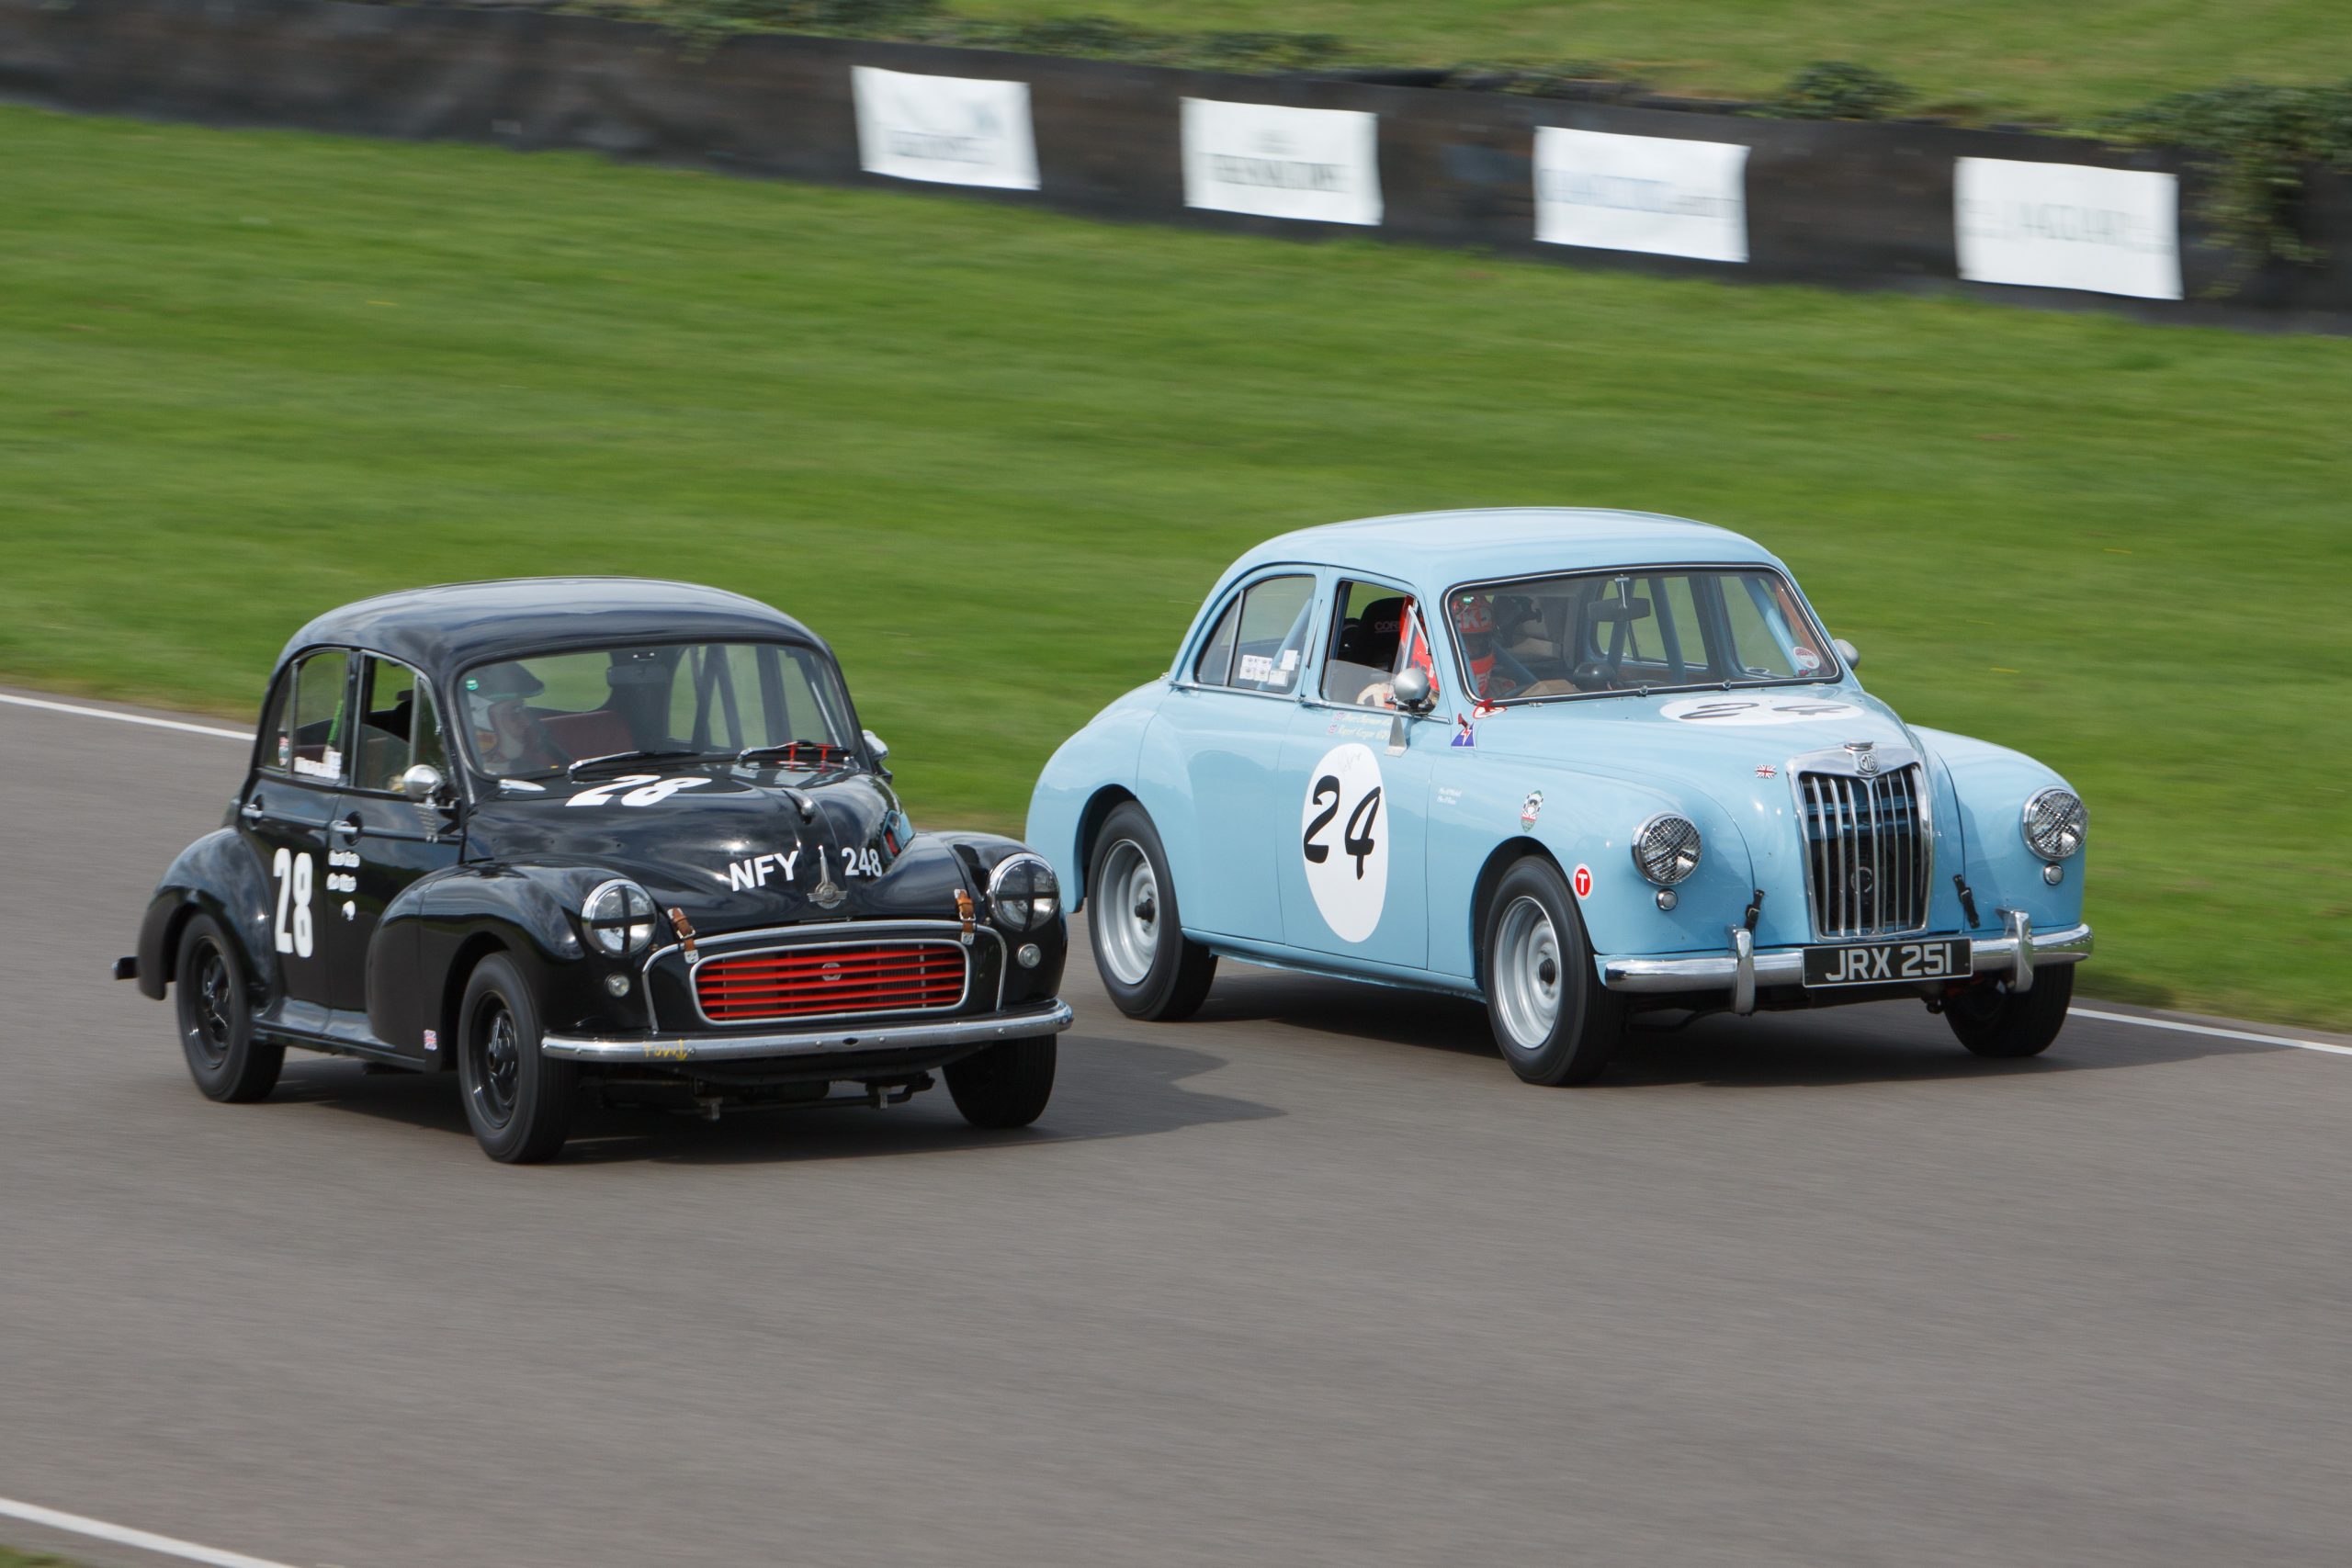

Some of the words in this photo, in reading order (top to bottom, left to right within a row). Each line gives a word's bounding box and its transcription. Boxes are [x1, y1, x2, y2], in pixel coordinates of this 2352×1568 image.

[1679, 702, 1851, 720] 24
[565, 774, 712, 807] 28
[1303, 774, 1381, 881] 24
[729, 851, 799, 892] NFY
[842, 847, 883, 877] 248
[1577, 873, 1589, 893] T
[273, 847, 313, 958] 28
[1826, 946, 1892, 982] JRX
[1901, 942, 1952, 976] 251
